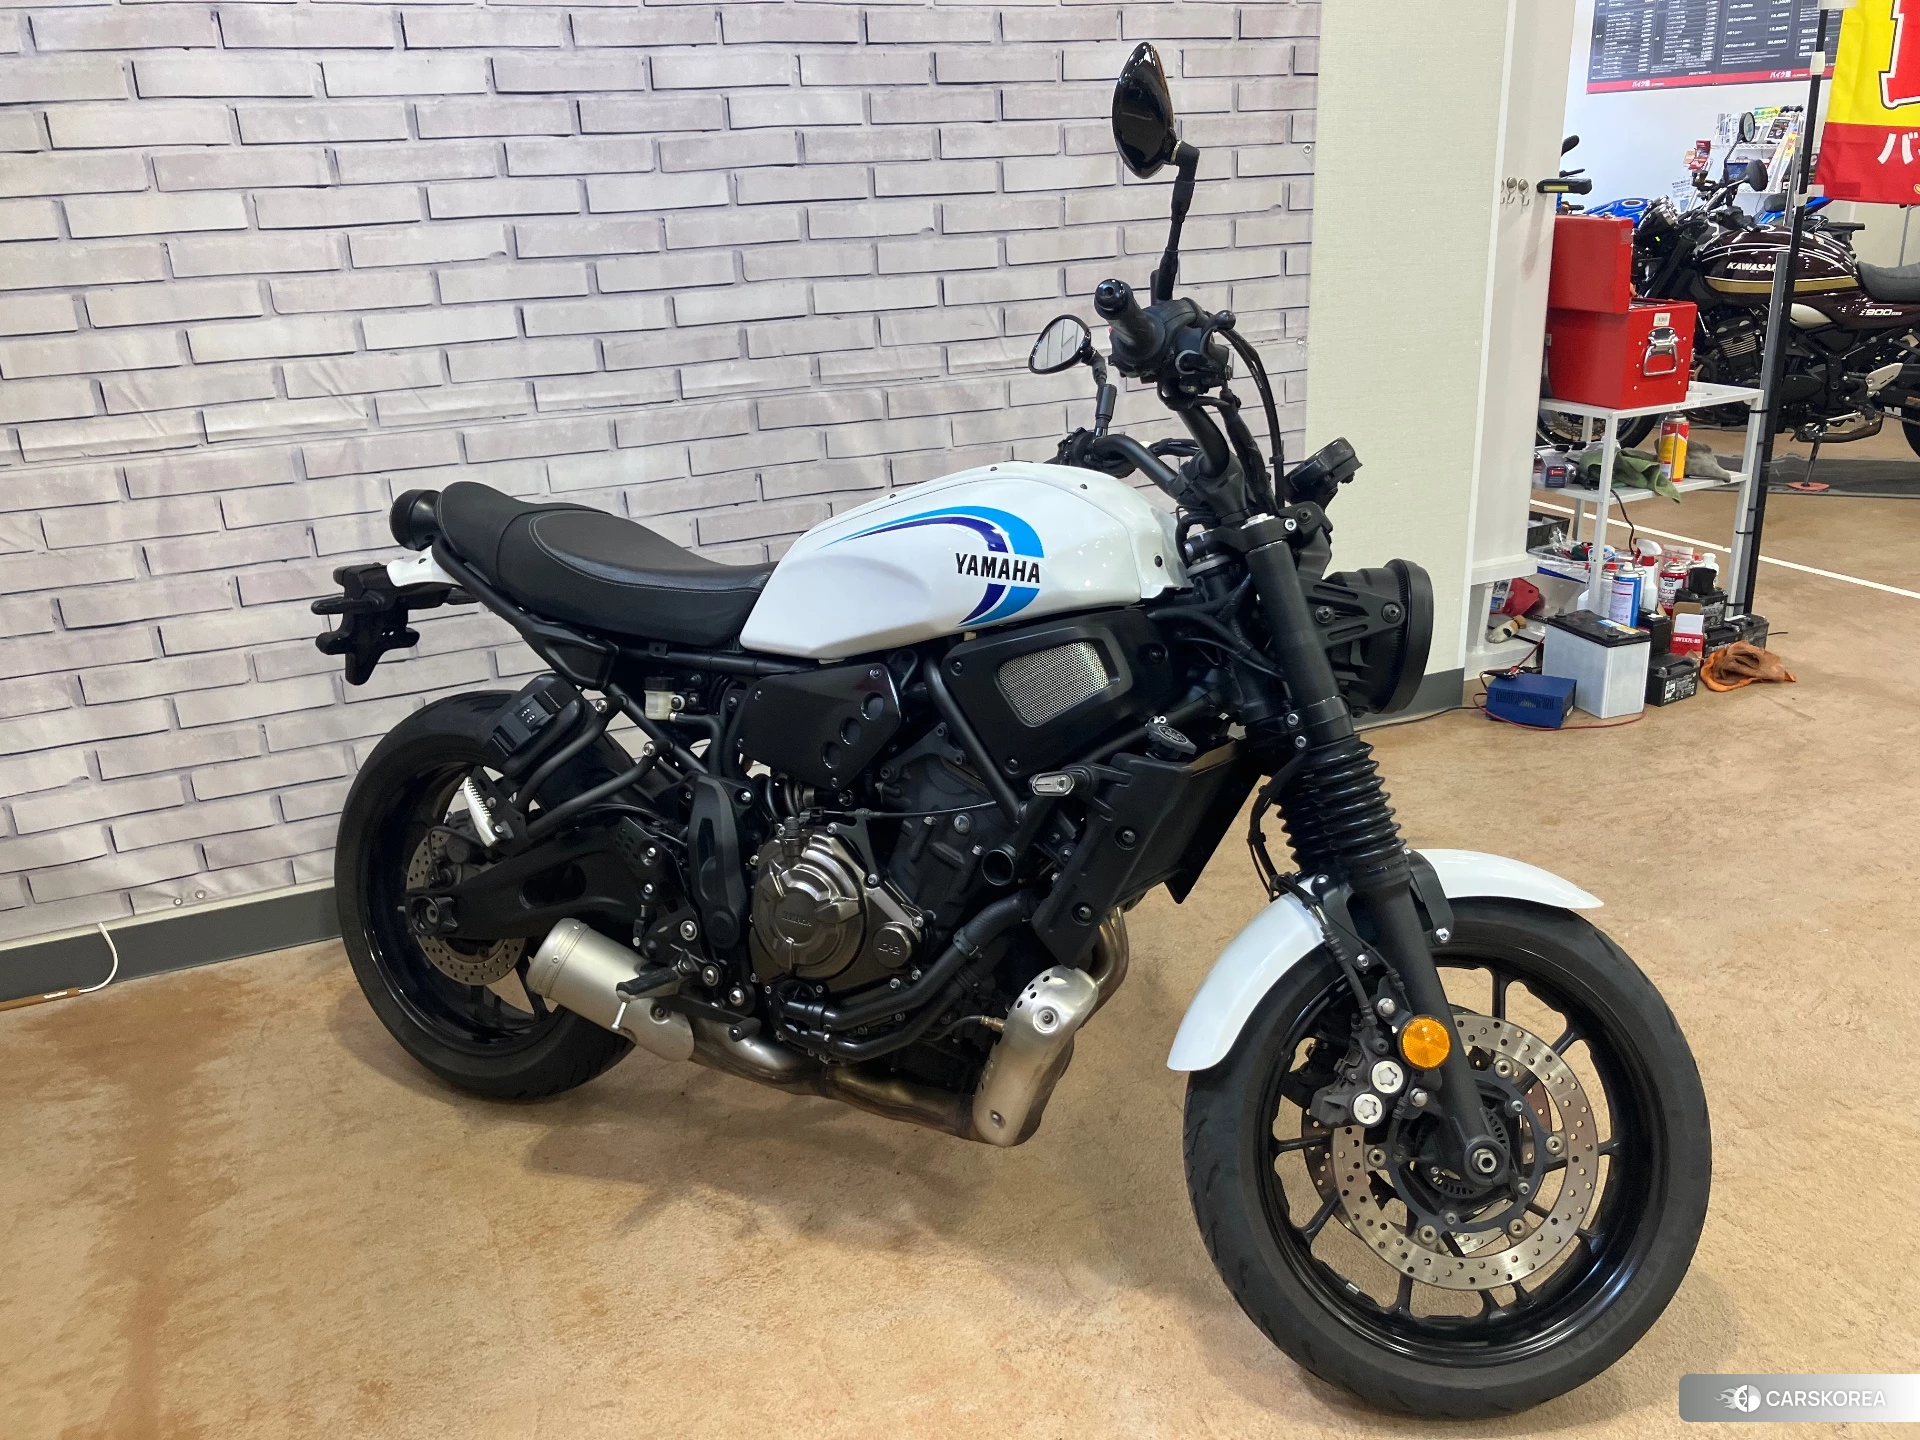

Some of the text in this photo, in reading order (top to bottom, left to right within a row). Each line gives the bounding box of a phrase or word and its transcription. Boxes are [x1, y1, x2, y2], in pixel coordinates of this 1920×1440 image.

[1877, 131, 1920, 166] バ
[1726, 262, 1776, 272] KAWASA
[955, 552, 1040, 584] YAMAHA
